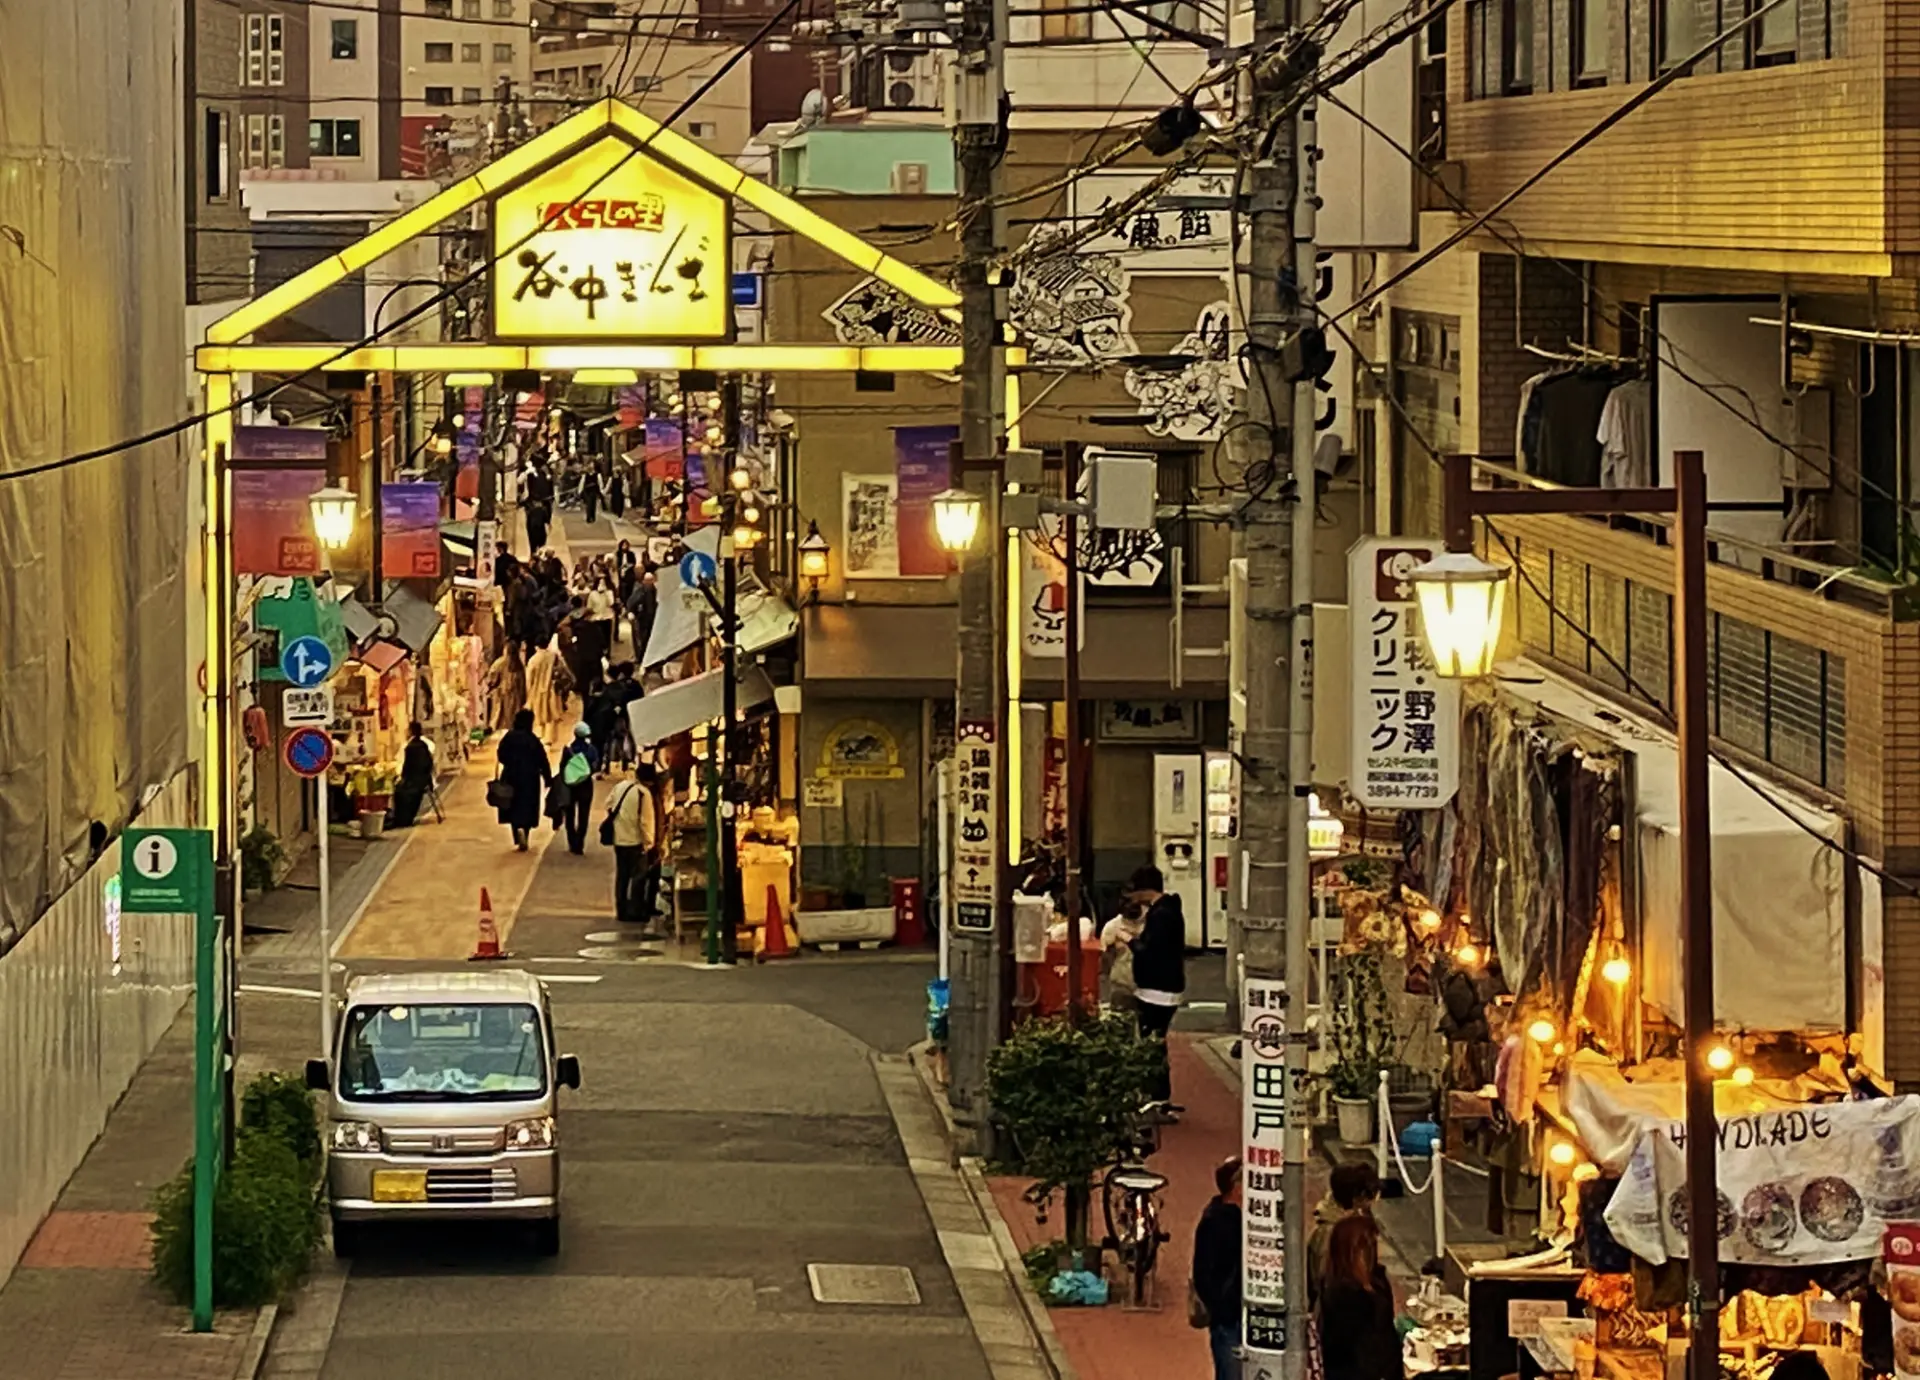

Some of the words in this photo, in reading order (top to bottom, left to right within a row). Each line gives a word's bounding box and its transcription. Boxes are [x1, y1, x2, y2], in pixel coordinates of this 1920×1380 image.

[512, 223, 710, 320] 谷中ぎんざ
[1370, 607, 1401, 752] クリニック
